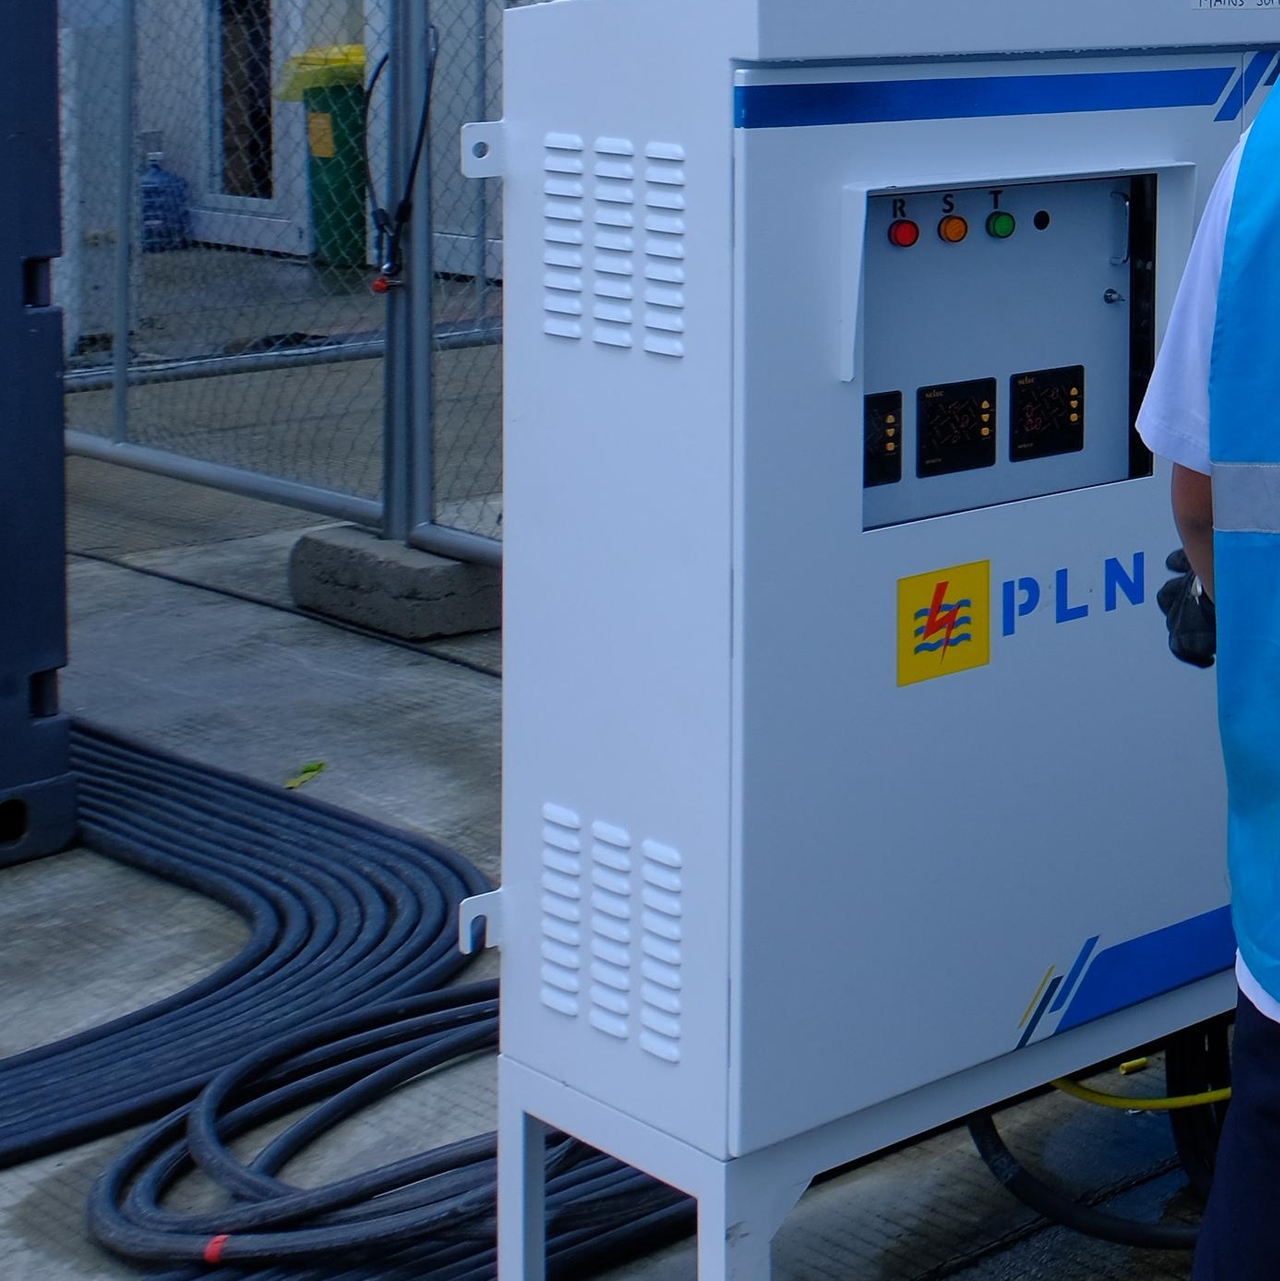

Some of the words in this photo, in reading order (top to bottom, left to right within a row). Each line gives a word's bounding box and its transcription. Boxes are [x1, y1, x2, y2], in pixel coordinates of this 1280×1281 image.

[892, 198, 906, 219] R
[943, 194, 955, 214] S
[989, 190, 1003, 210] T
[1002, 551, 1145, 637] PLN
